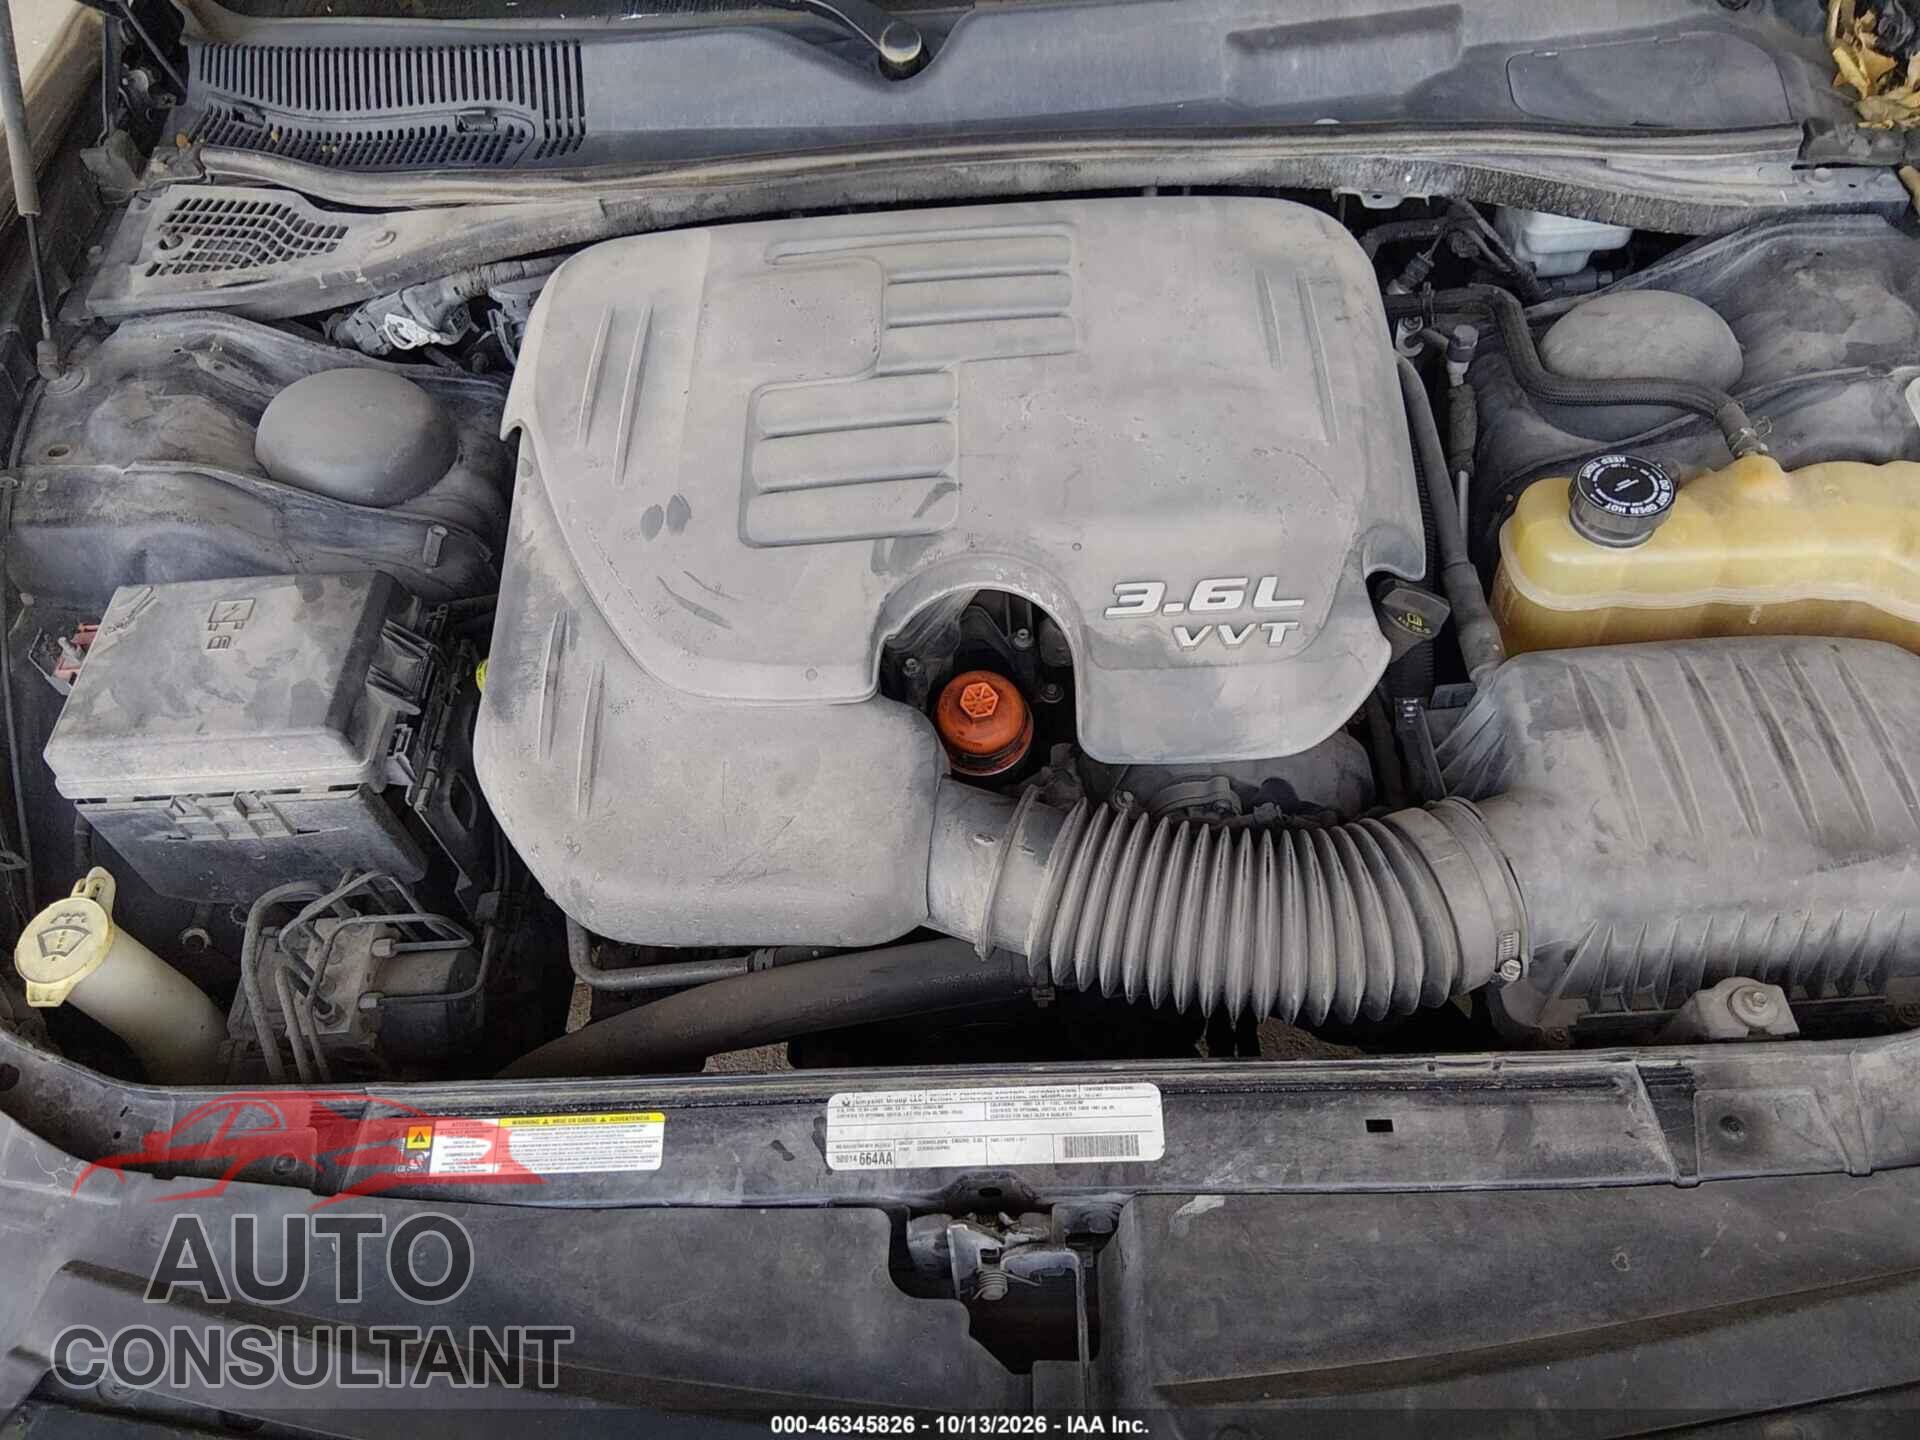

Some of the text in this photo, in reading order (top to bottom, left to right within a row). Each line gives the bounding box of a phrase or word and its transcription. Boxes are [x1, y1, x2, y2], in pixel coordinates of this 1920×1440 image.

[1600, 456, 1627, 464] KEEP
[1605, 479, 1670, 514] DO NOT OPEN HOT
[1104, 576, 1305, 619] 3.6L
[1173, 621, 1300, 651] VVT
[859, 1151, 893, 1166] 664AA
